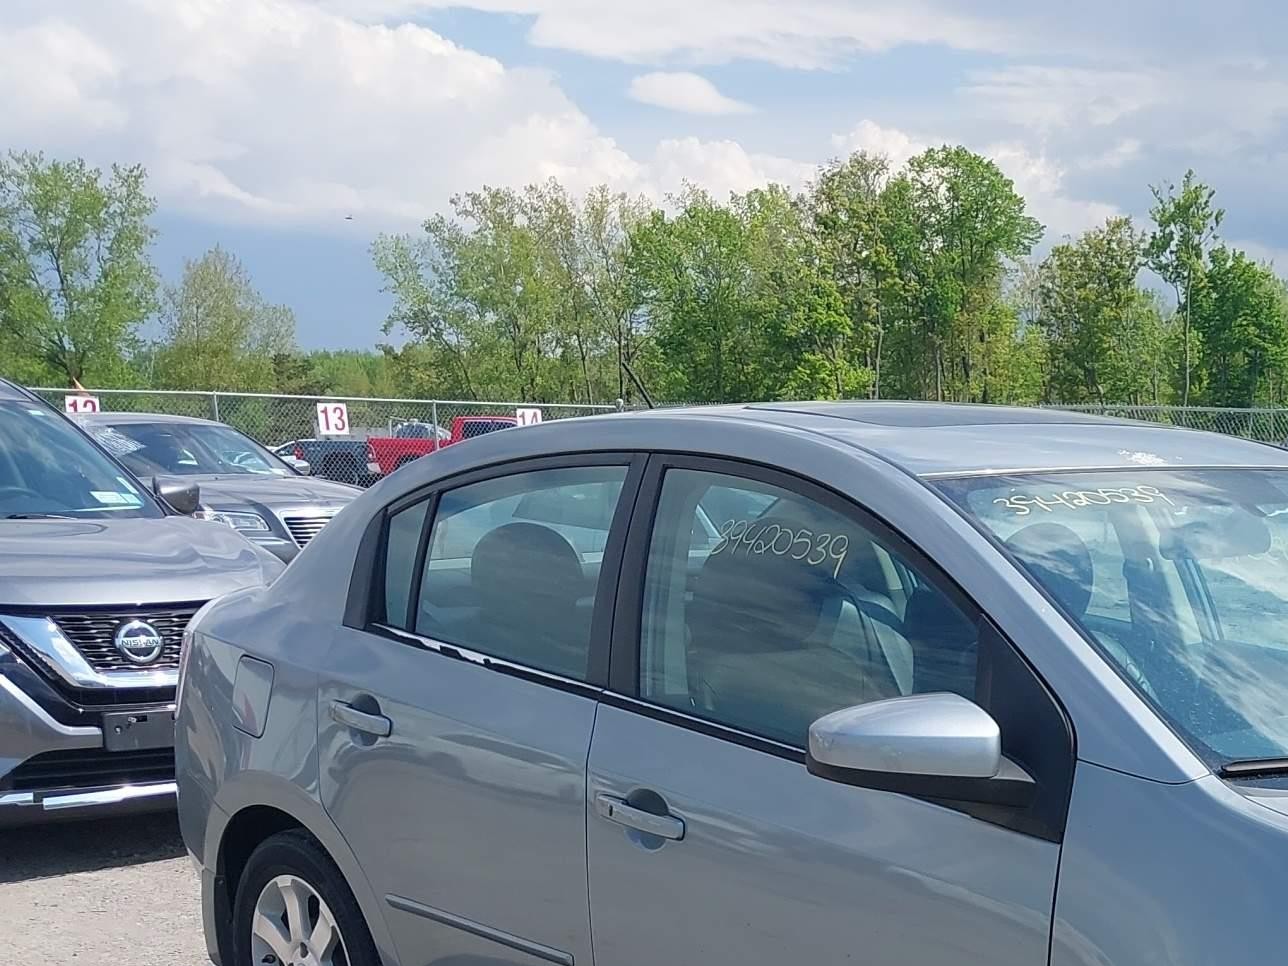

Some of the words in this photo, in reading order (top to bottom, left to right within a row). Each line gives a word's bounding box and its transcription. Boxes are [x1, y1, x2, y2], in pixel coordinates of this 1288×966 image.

[320, 406, 346, 431] 13
[711, 519, 849, 579] 39420539
[121, 639, 159, 647] NISAN
